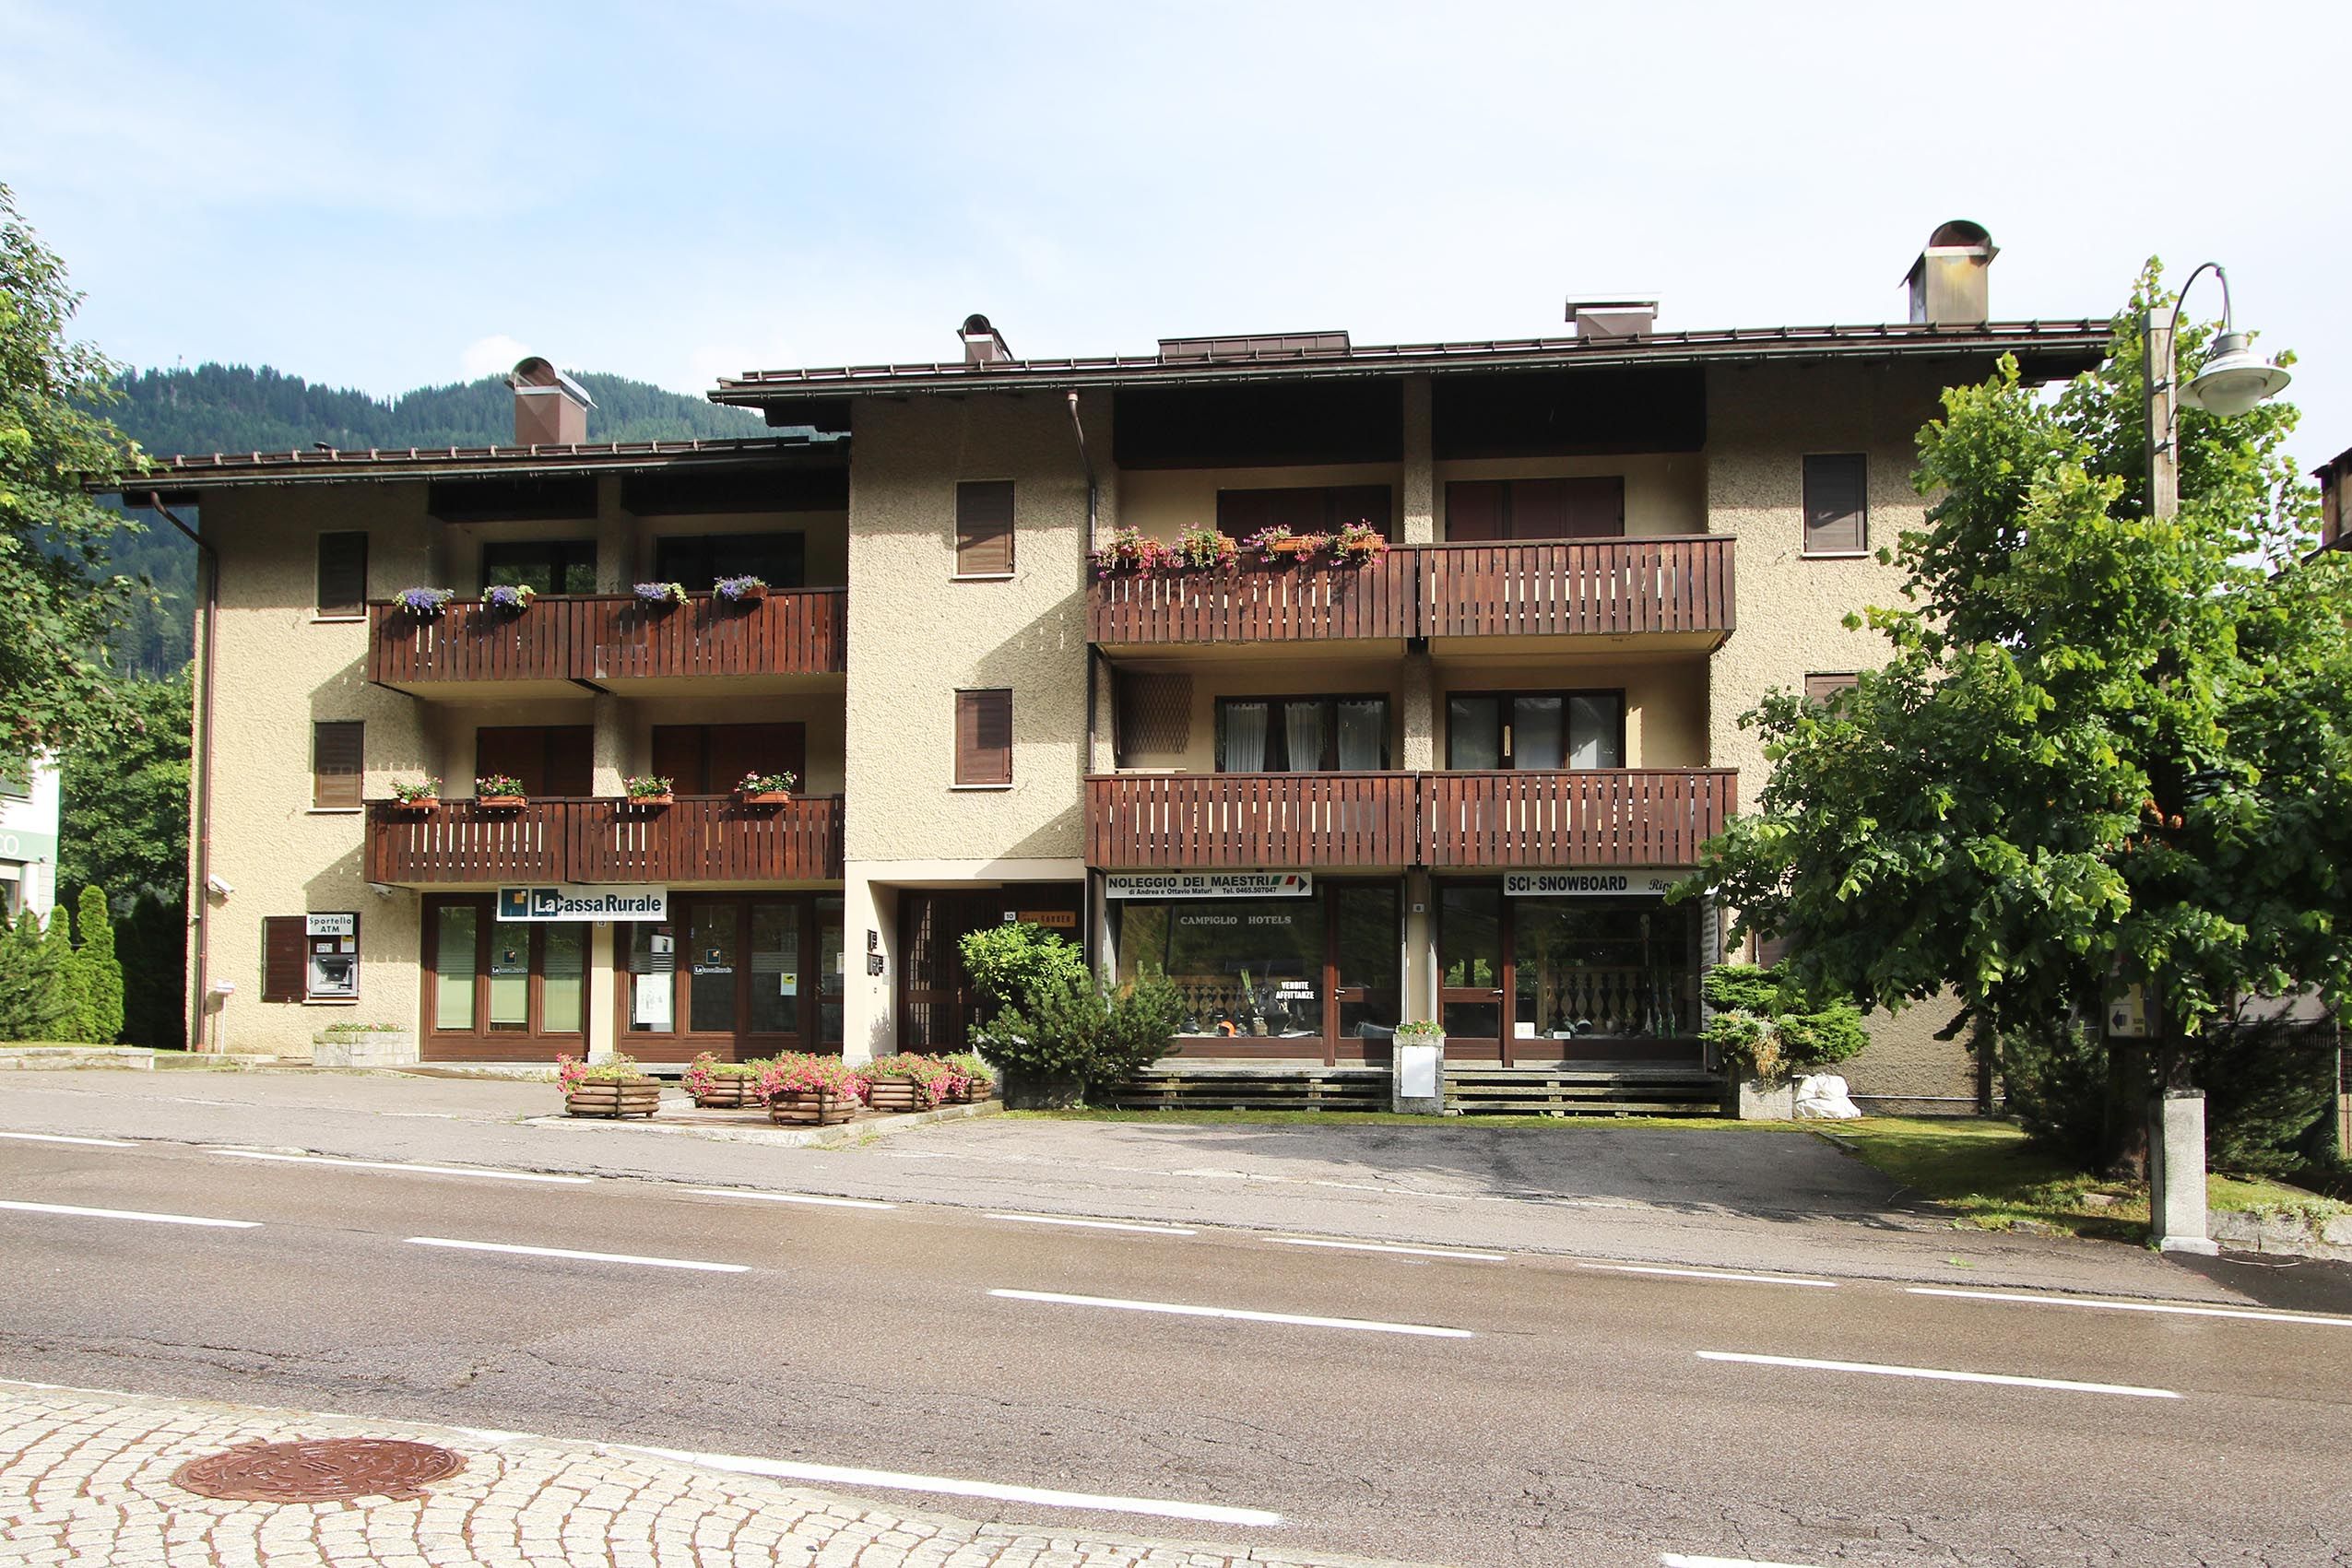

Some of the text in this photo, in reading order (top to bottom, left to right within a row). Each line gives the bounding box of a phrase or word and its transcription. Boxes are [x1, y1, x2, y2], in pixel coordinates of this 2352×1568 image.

[1108, 876, 1269, 888] NOLEGGIO DEI MAESTRI
[309, 916, 352, 925] Sportello
[1180, 916, 1237, 925] CAMPIGLIO
[1281, 981, 1309, 990] VENDITE
[1275, 991, 1315, 999] AFFITTANZE
